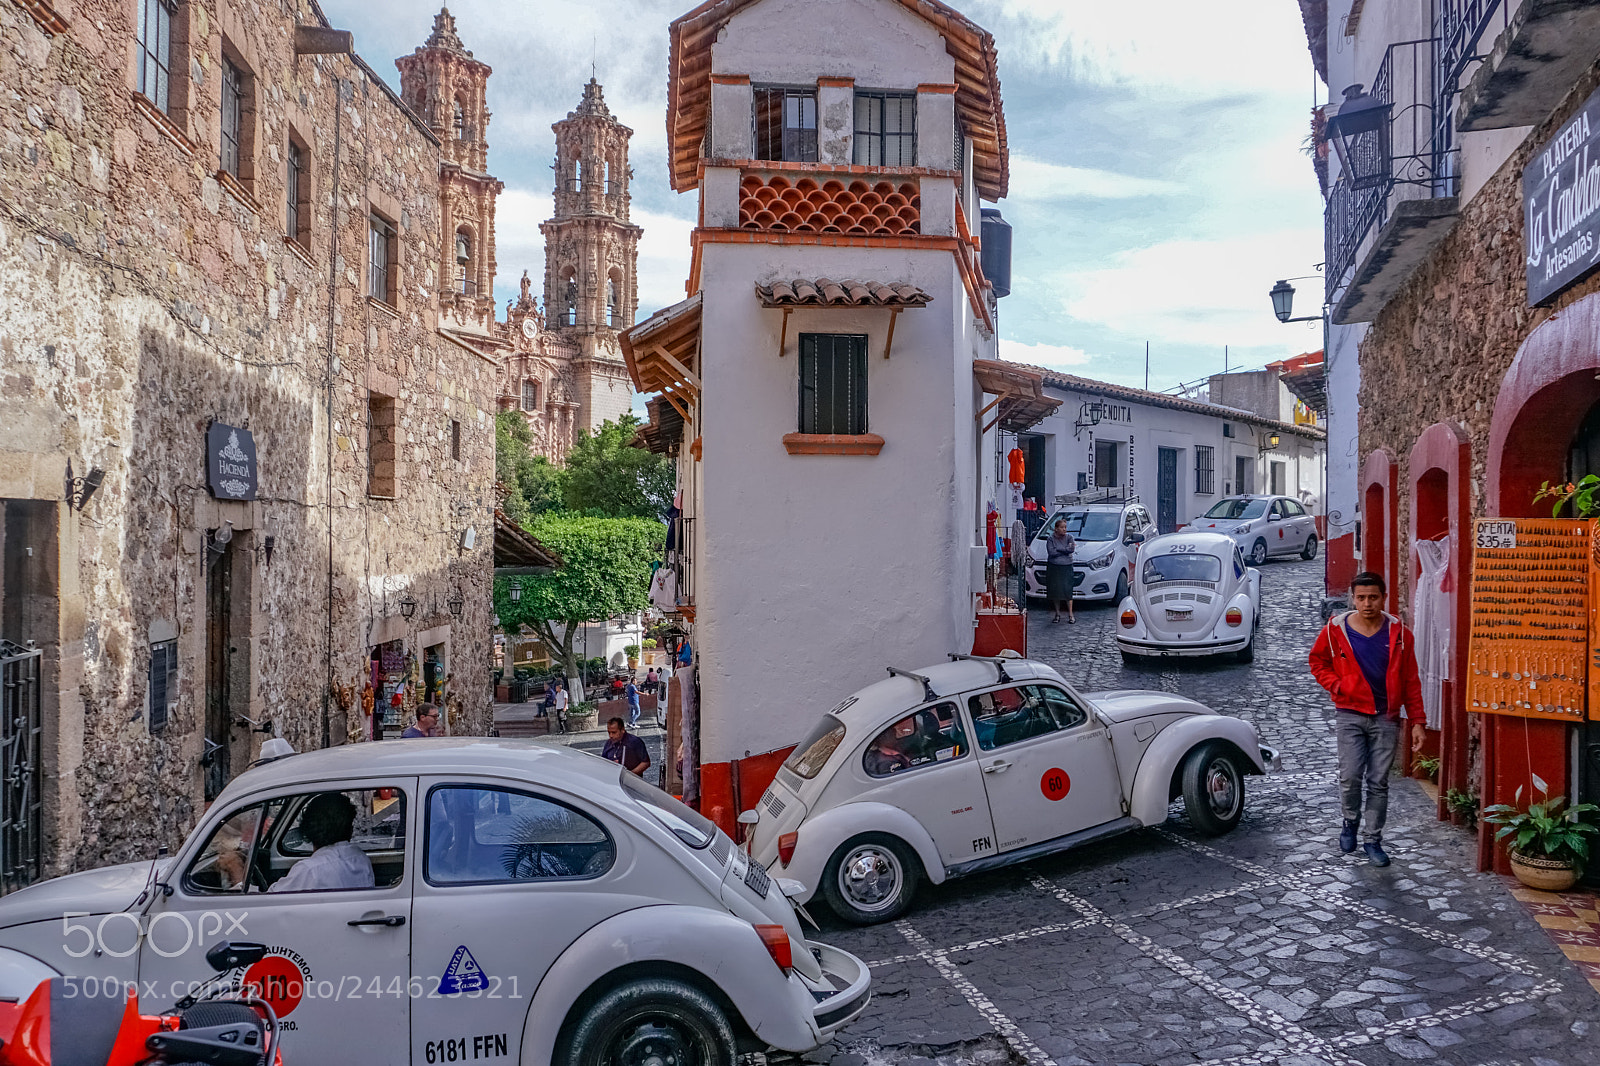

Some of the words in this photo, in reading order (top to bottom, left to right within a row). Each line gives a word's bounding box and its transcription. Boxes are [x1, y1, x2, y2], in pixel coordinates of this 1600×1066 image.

[1543, 111, 1590, 179] PLATERIA
[1527, 198, 1544, 267] La
[1170, 544, 1196, 553] 292
[1048, 776, 1063, 792] 60
[972, 836, 992, 853] FFN
[425, 1037, 467, 1065] 6181
[473, 1033, 508, 1060] FFN
